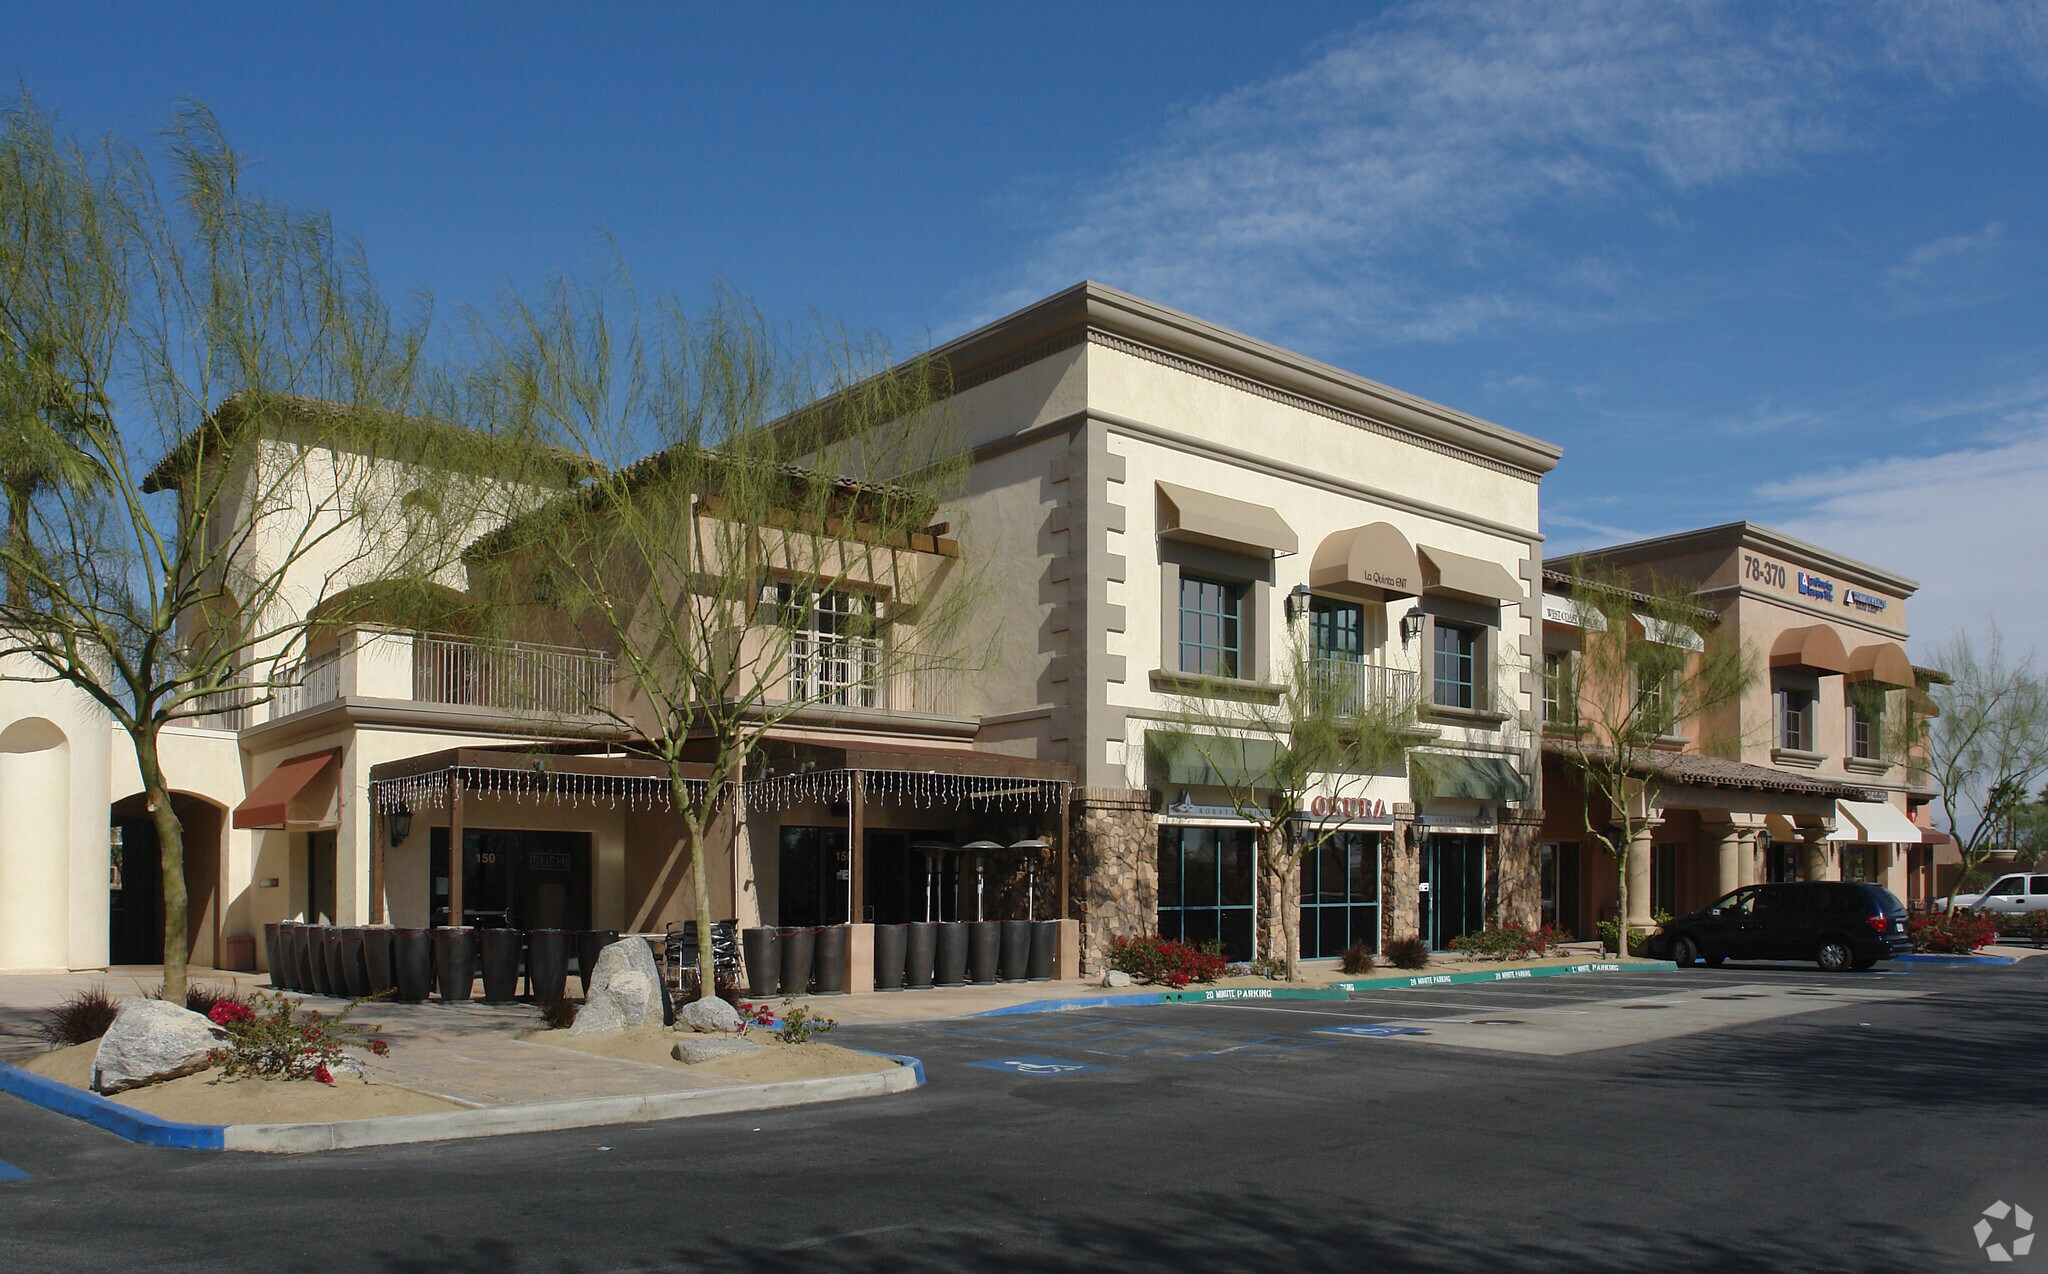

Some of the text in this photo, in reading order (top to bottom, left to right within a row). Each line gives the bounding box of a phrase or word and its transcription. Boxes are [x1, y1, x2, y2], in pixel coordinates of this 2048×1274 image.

[1364, 570, 1372, 580] La
[1373, 572, 1394, 586] Quinta
[1744, 555, 1786, 589] 78-370
[1311, 795, 1387, 818] OKURA
[476, 853, 496, 863] 150
[532, 855, 568, 868] SUSHI
[1410, 978, 1417, 986] 20
[1206, 989, 1272, 999] 20 MINUTE PARKING
